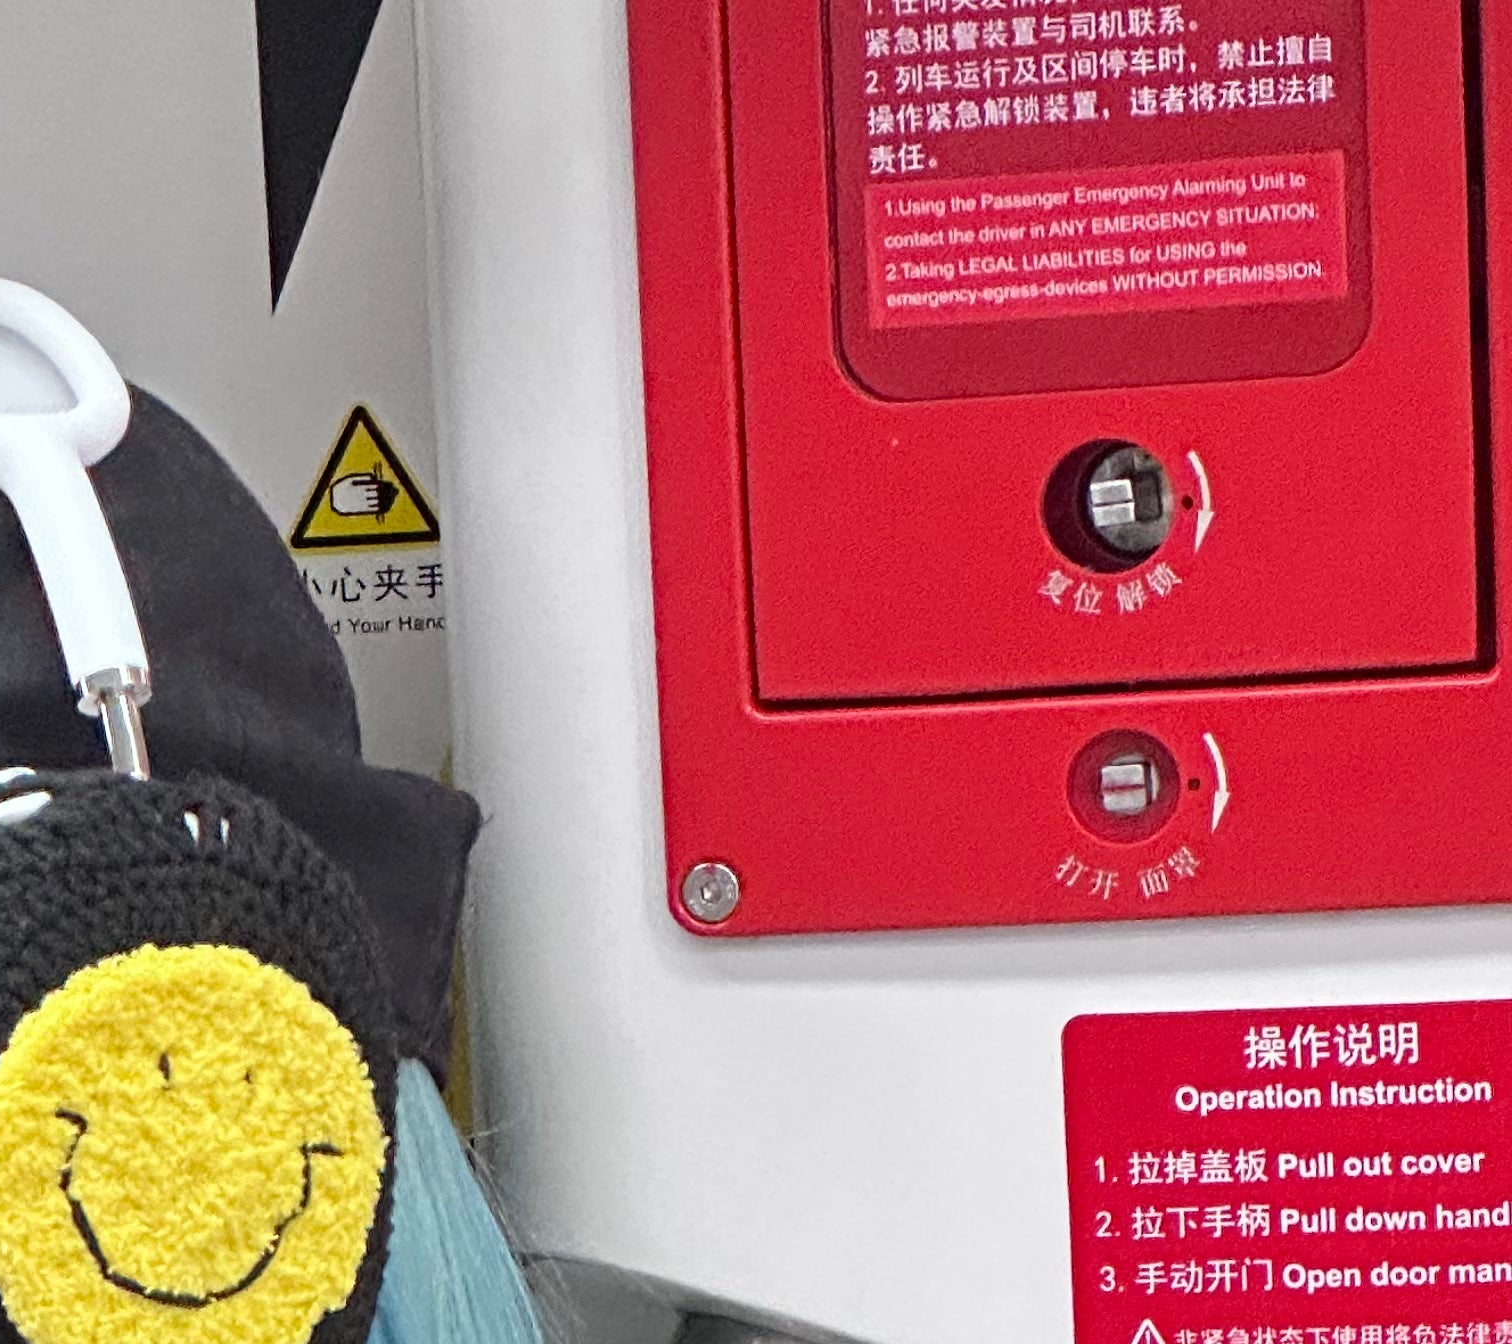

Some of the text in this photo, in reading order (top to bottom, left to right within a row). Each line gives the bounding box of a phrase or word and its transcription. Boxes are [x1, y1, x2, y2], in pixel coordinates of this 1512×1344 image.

[865, 4, 1198, 58] 紧急报警装置与司机联系。
[869, 142, 937, 174] 责任。
[951, 196, 976, 213] the
[981, 191, 1069, 210] Passenger
[1074, 184, 1168, 205] Emergency
[1172, 177, 1246, 196] Alarming
[1251, 173, 1284, 191] Unit
[1290, 172, 1306, 188] to
[884, 229, 944, 248] contact
[948, 227, 976, 244] the
[978, 224, 1025, 243] driver
[1030, 222, 1045, 240] in
[1049, 219, 1086, 237] ANY
[1091, 208, 1211, 235] EMERGENCY
[958, 255, 1017, 276] LEGAL
[1022, 248, 1125, 272] LIABILITIES
[1129, 246, 1151, 264] for
[1156, 241, 1215, 262] USING
[1220, 239, 1247, 257] the
[1112, 270, 1199, 292] WITHOUT
[348, 618, 391, 633] Your
[1244, 1021, 1420, 1069] 操作说明
[1175, 1077, 1492, 1117] Operation Instruction
[1129, 1148, 1269, 1185] 拉掉盖板
[1278, 1152, 1334, 1179] Pull
[1343, 1152, 1393, 1177] out
[1401, 1152, 1485, 1175] cover
[1132, 1202, 1271, 1240] 拉下手柄
[1280, 1207, 1336, 1234] Pull
[1345, 1206, 1426, 1232] down
[1436, 1200, 1512, 1230] hand
[1135, 1257, 1274, 1294] 手动开门
[1282, 1263, 1361, 1294] Open
[1371, 1261, 1441, 1286] door
[1448, 1263, 1512, 1285] man
